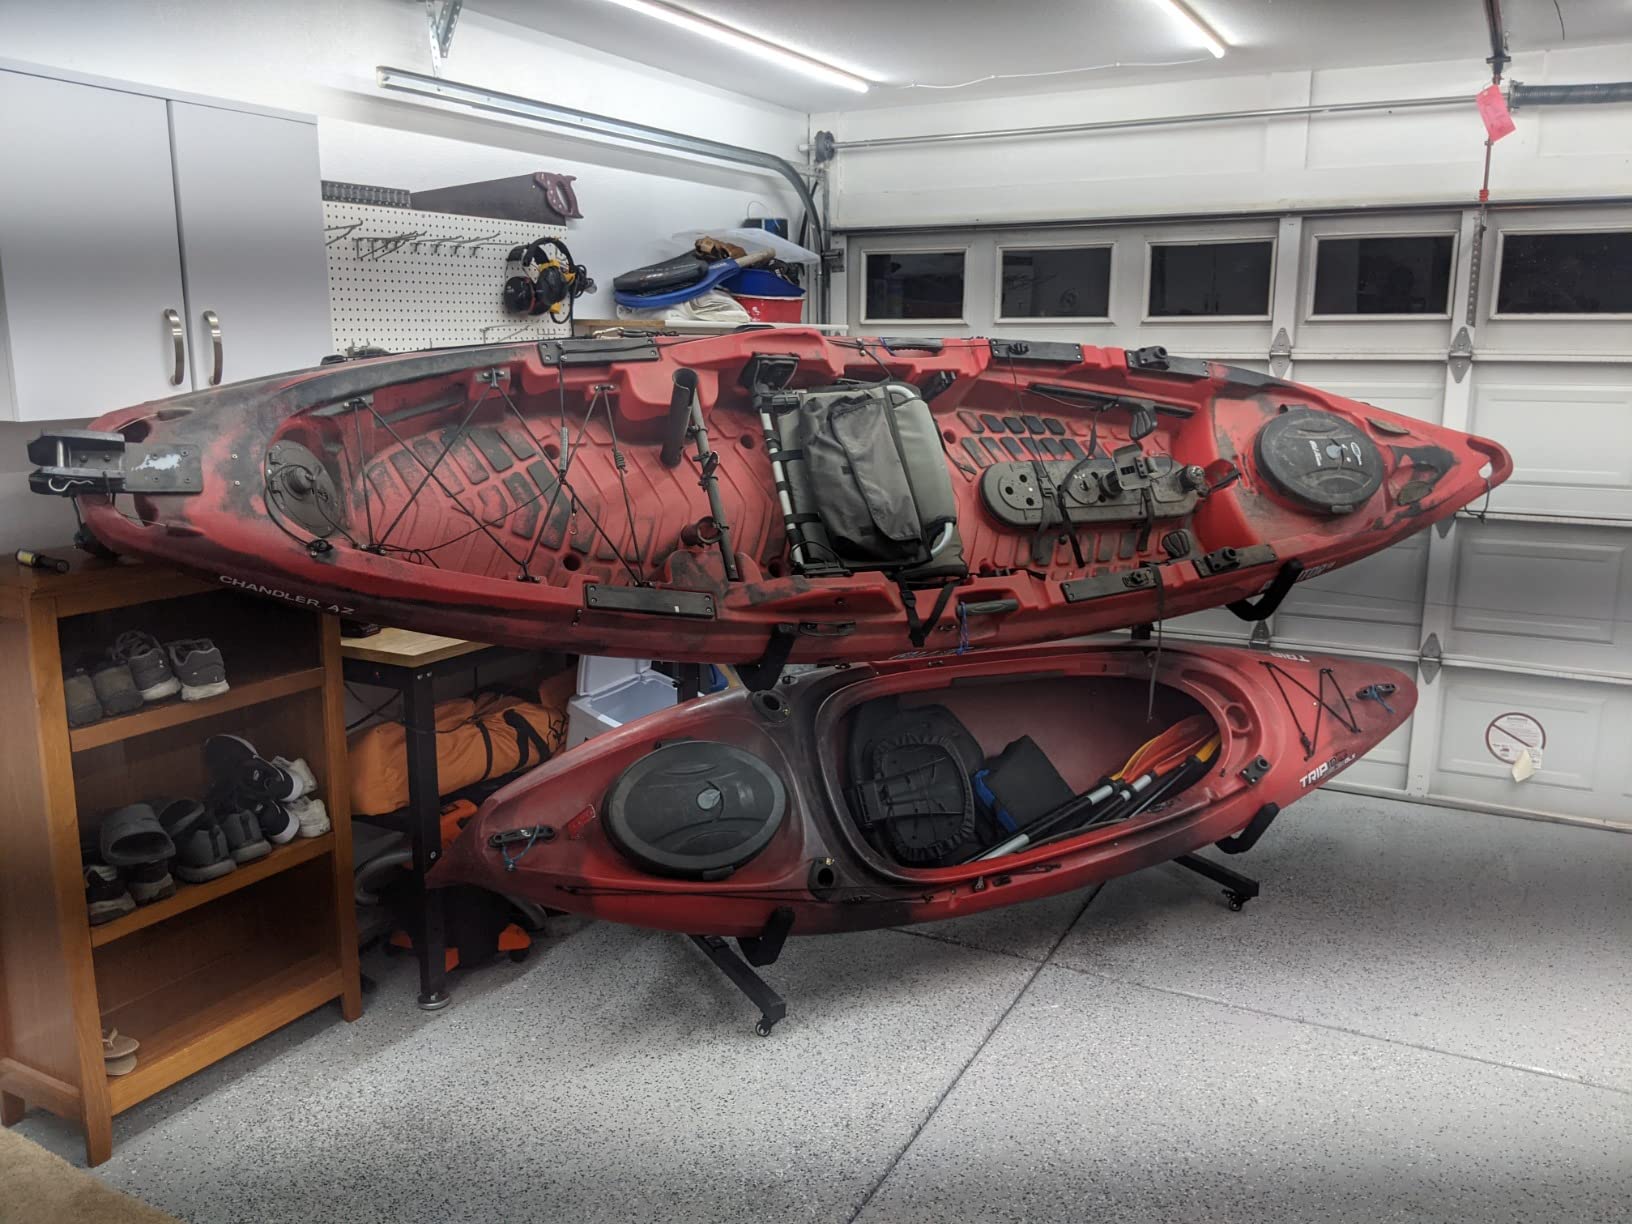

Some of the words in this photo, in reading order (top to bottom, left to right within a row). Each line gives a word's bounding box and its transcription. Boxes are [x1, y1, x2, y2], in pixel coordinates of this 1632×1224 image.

[219, 575, 321, 608] CHANDLER
[327, 605, 355, 615] AZ
[1299, 762, 1328, 788] TRIP
